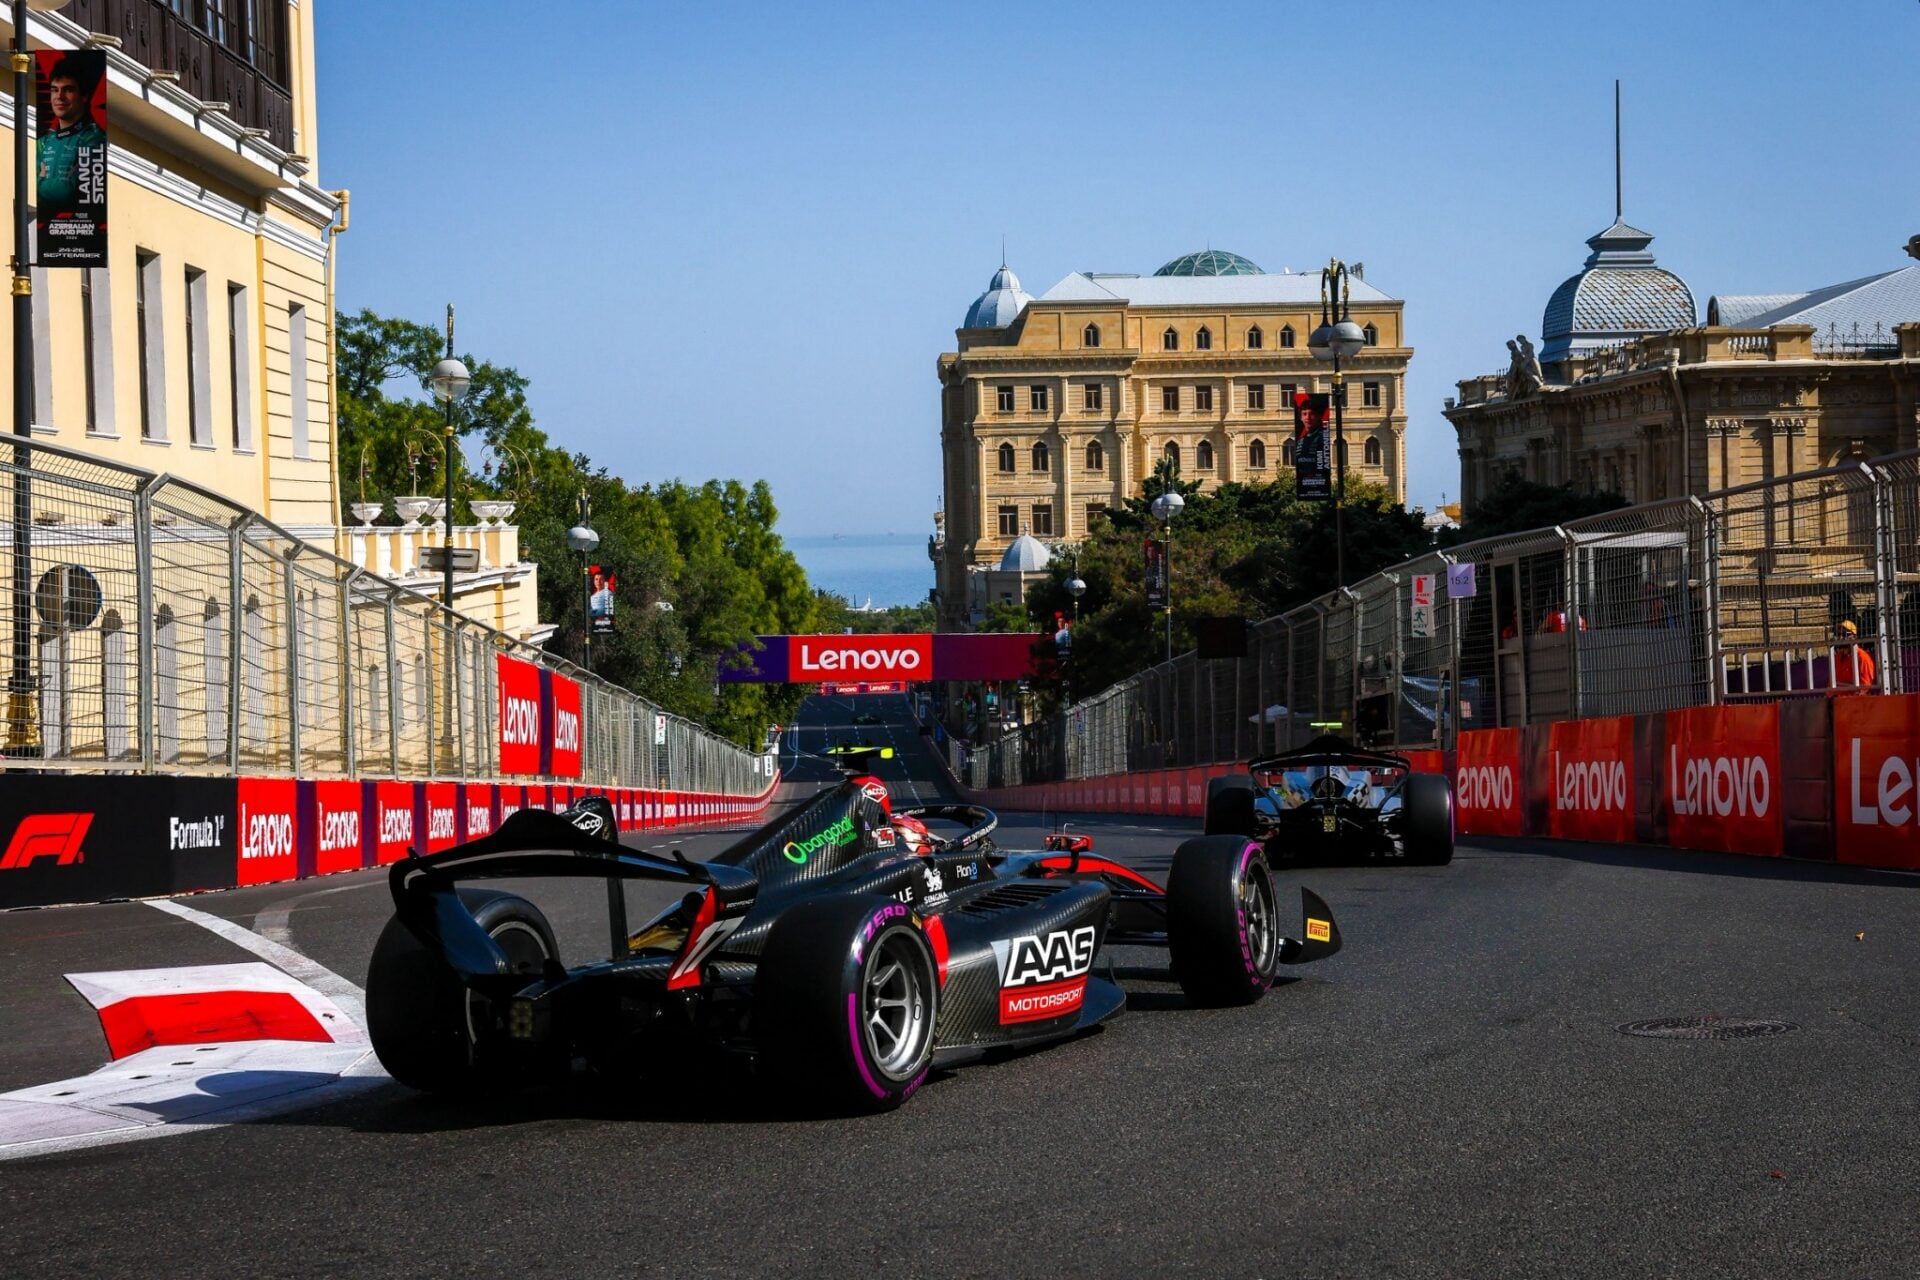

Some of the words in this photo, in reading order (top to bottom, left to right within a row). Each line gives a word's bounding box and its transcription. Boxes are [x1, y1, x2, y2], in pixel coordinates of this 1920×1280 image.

[79, 147, 90, 204] LANCE
[92, 143, 104, 204] STROLL
[1450, 576, 1469, 585] 15.2
[801, 644, 920, 670] Lenovo
[501, 681, 538, 746] Lenovo
[554, 696, 578, 753] Lenovo
[1457, 765, 1513, 810] enovo
[1555, 750, 1626, 811] Lenovo
[1671, 744, 1770, 818] Lenovo
[1851, 738, 1920, 826] Le
[169, 816, 213, 850] Formula
[241, 802, 293, 859] Lenovo
[318, 801, 358, 851] Lenovo
[380, 800, 412, 844] Lenovo
[428, 800, 455, 840] Lenovo
[467, 798, 490, 836] Lenovo
[800, 815, 854, 853] bangchak
[0, 813, 95, 870] F1
[892, 886, 914, 903] LE
[923, 891, 949, 904] SINGHA
[863, 903, 907, 943] ZERO
[1003, 925, 1096, 988] AAS
[1009, 986, 1084, 1012] MOTORSPORT
